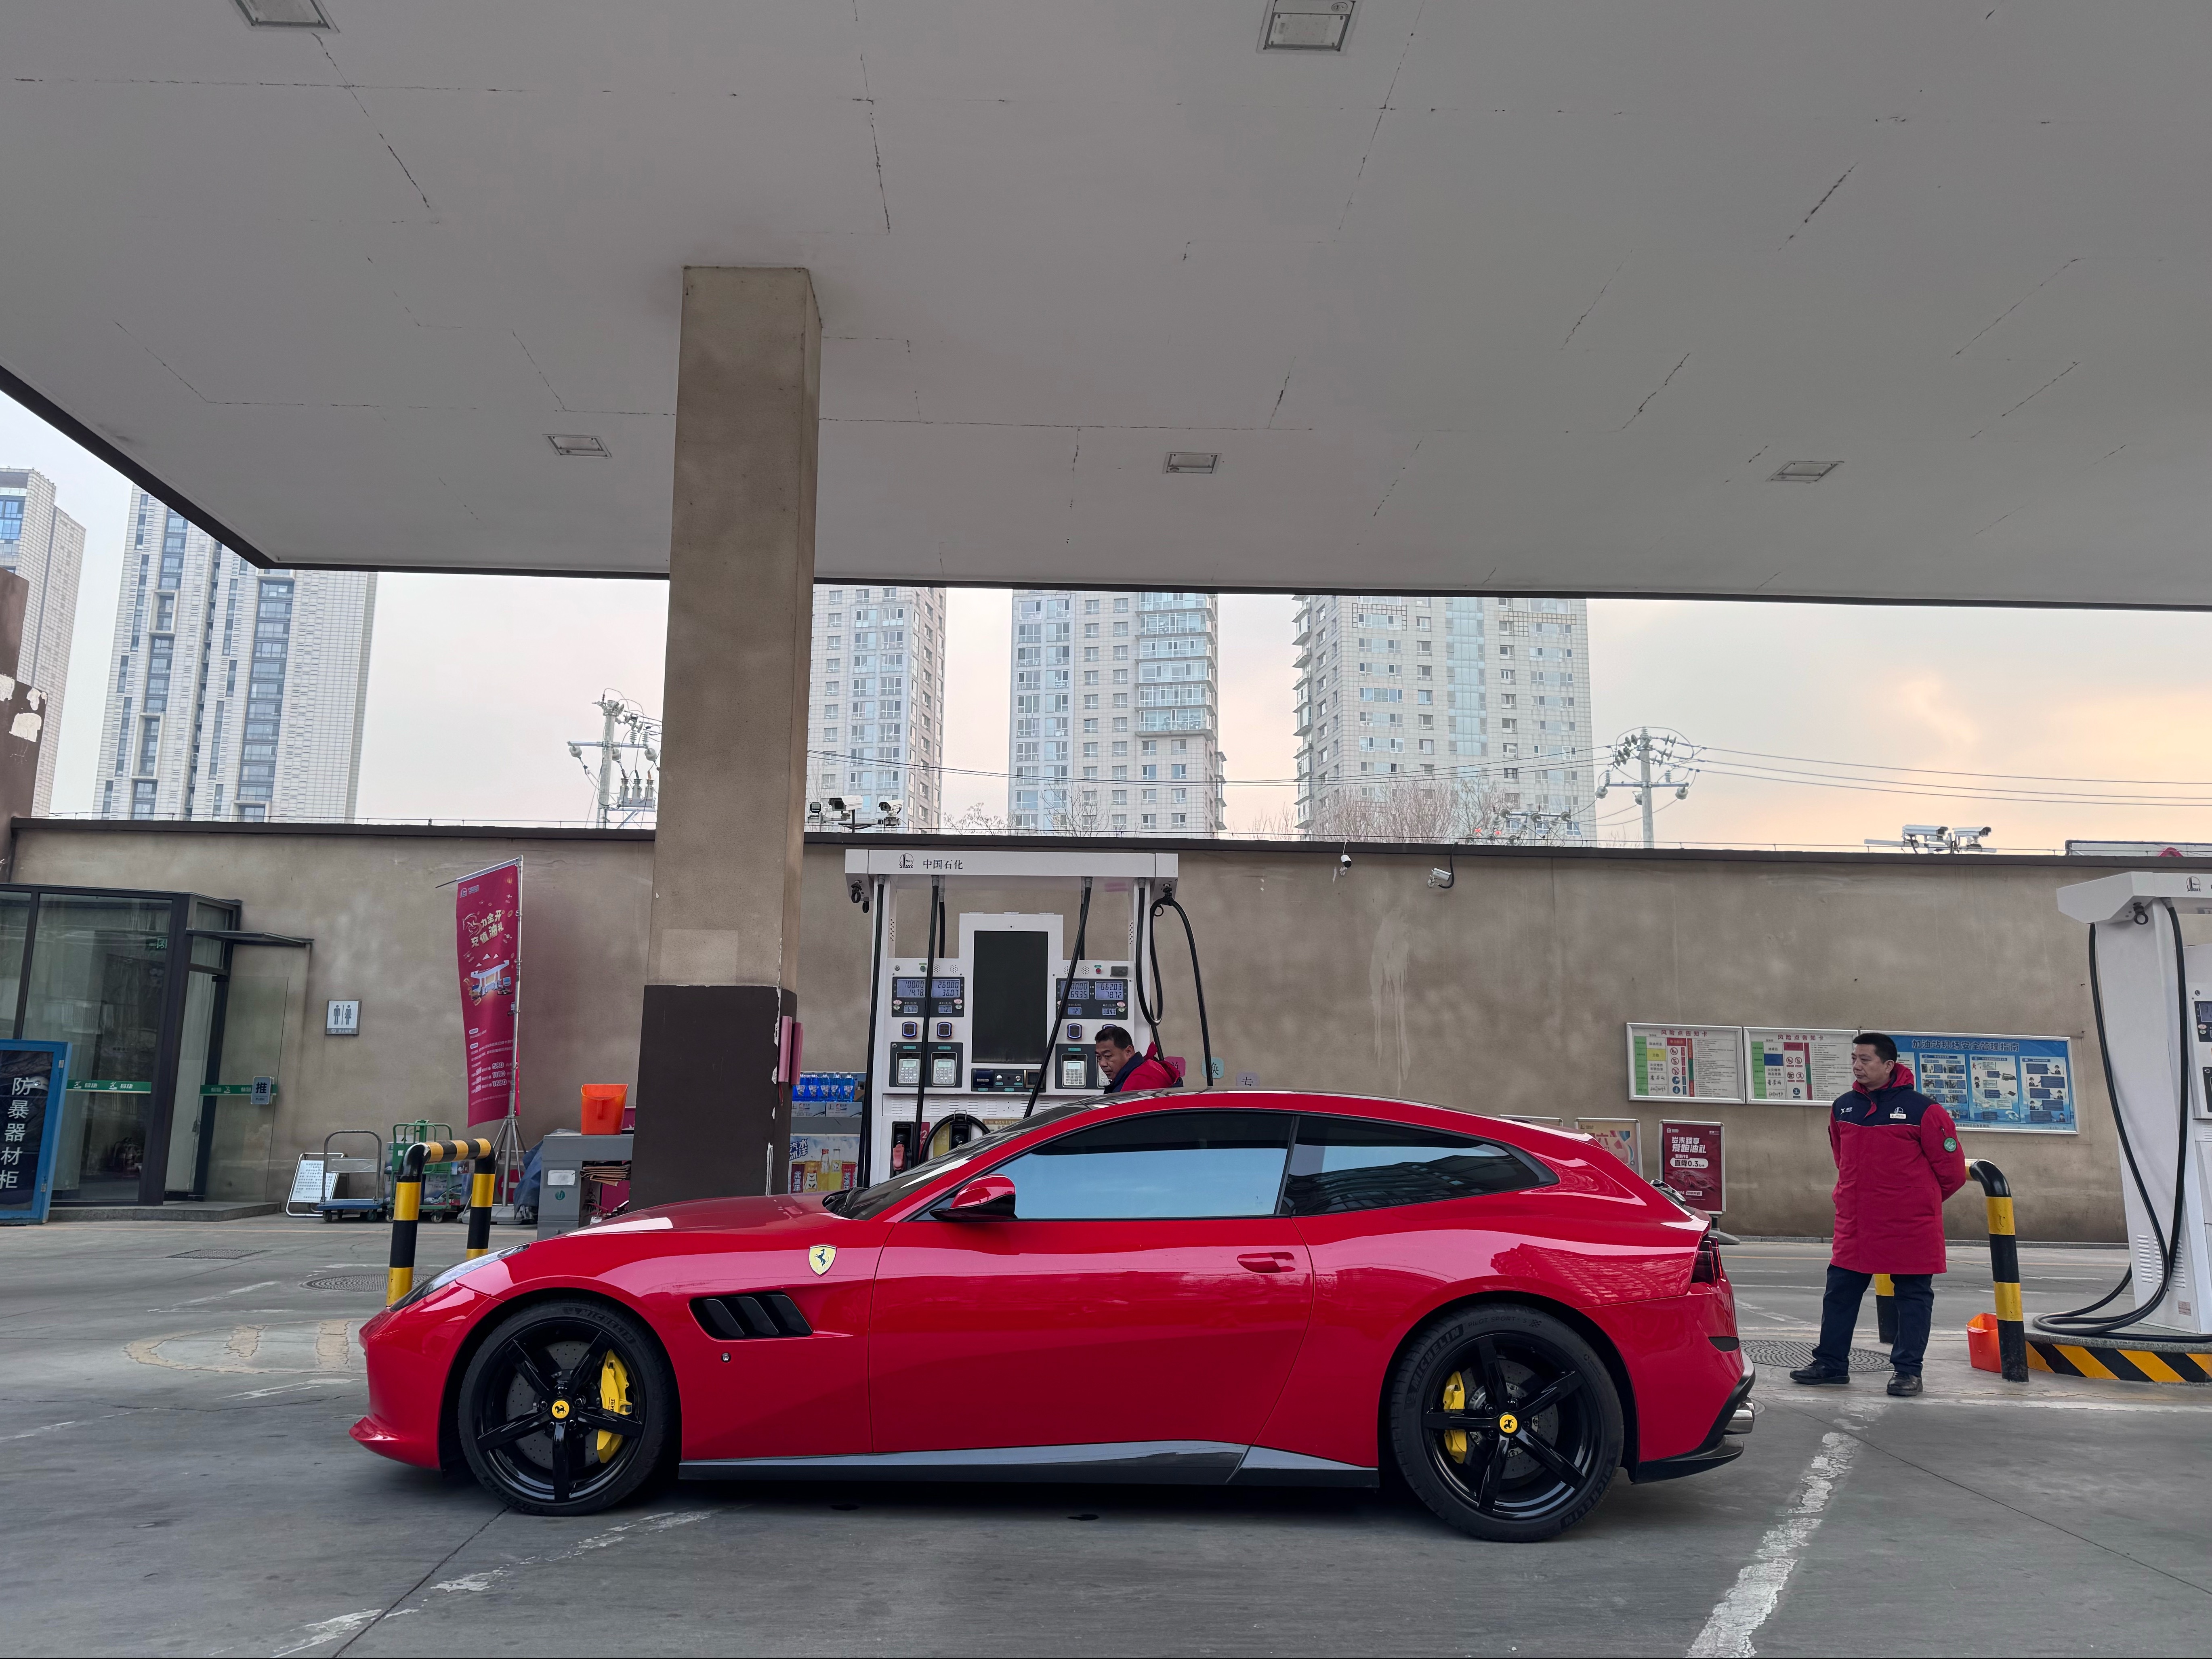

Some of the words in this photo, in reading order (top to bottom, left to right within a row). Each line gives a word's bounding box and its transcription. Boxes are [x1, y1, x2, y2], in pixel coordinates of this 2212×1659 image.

[923, 859, 963, 869] 中国石化
[471, 922, 504, 948] 充值油礼
[1912, 1039, 2019, 1052] 加油站现场安全管理指南
[256, 1082, 267, 1094] 推
[0, 1077, 33, 1189] 防暴器材柜
[1672, 1144, 1707, 1153] 爱跑油礼
[1468, 1317, 1488, 1328] PILOT
[1411, 1327, 1461, 1389] MICHELIN
